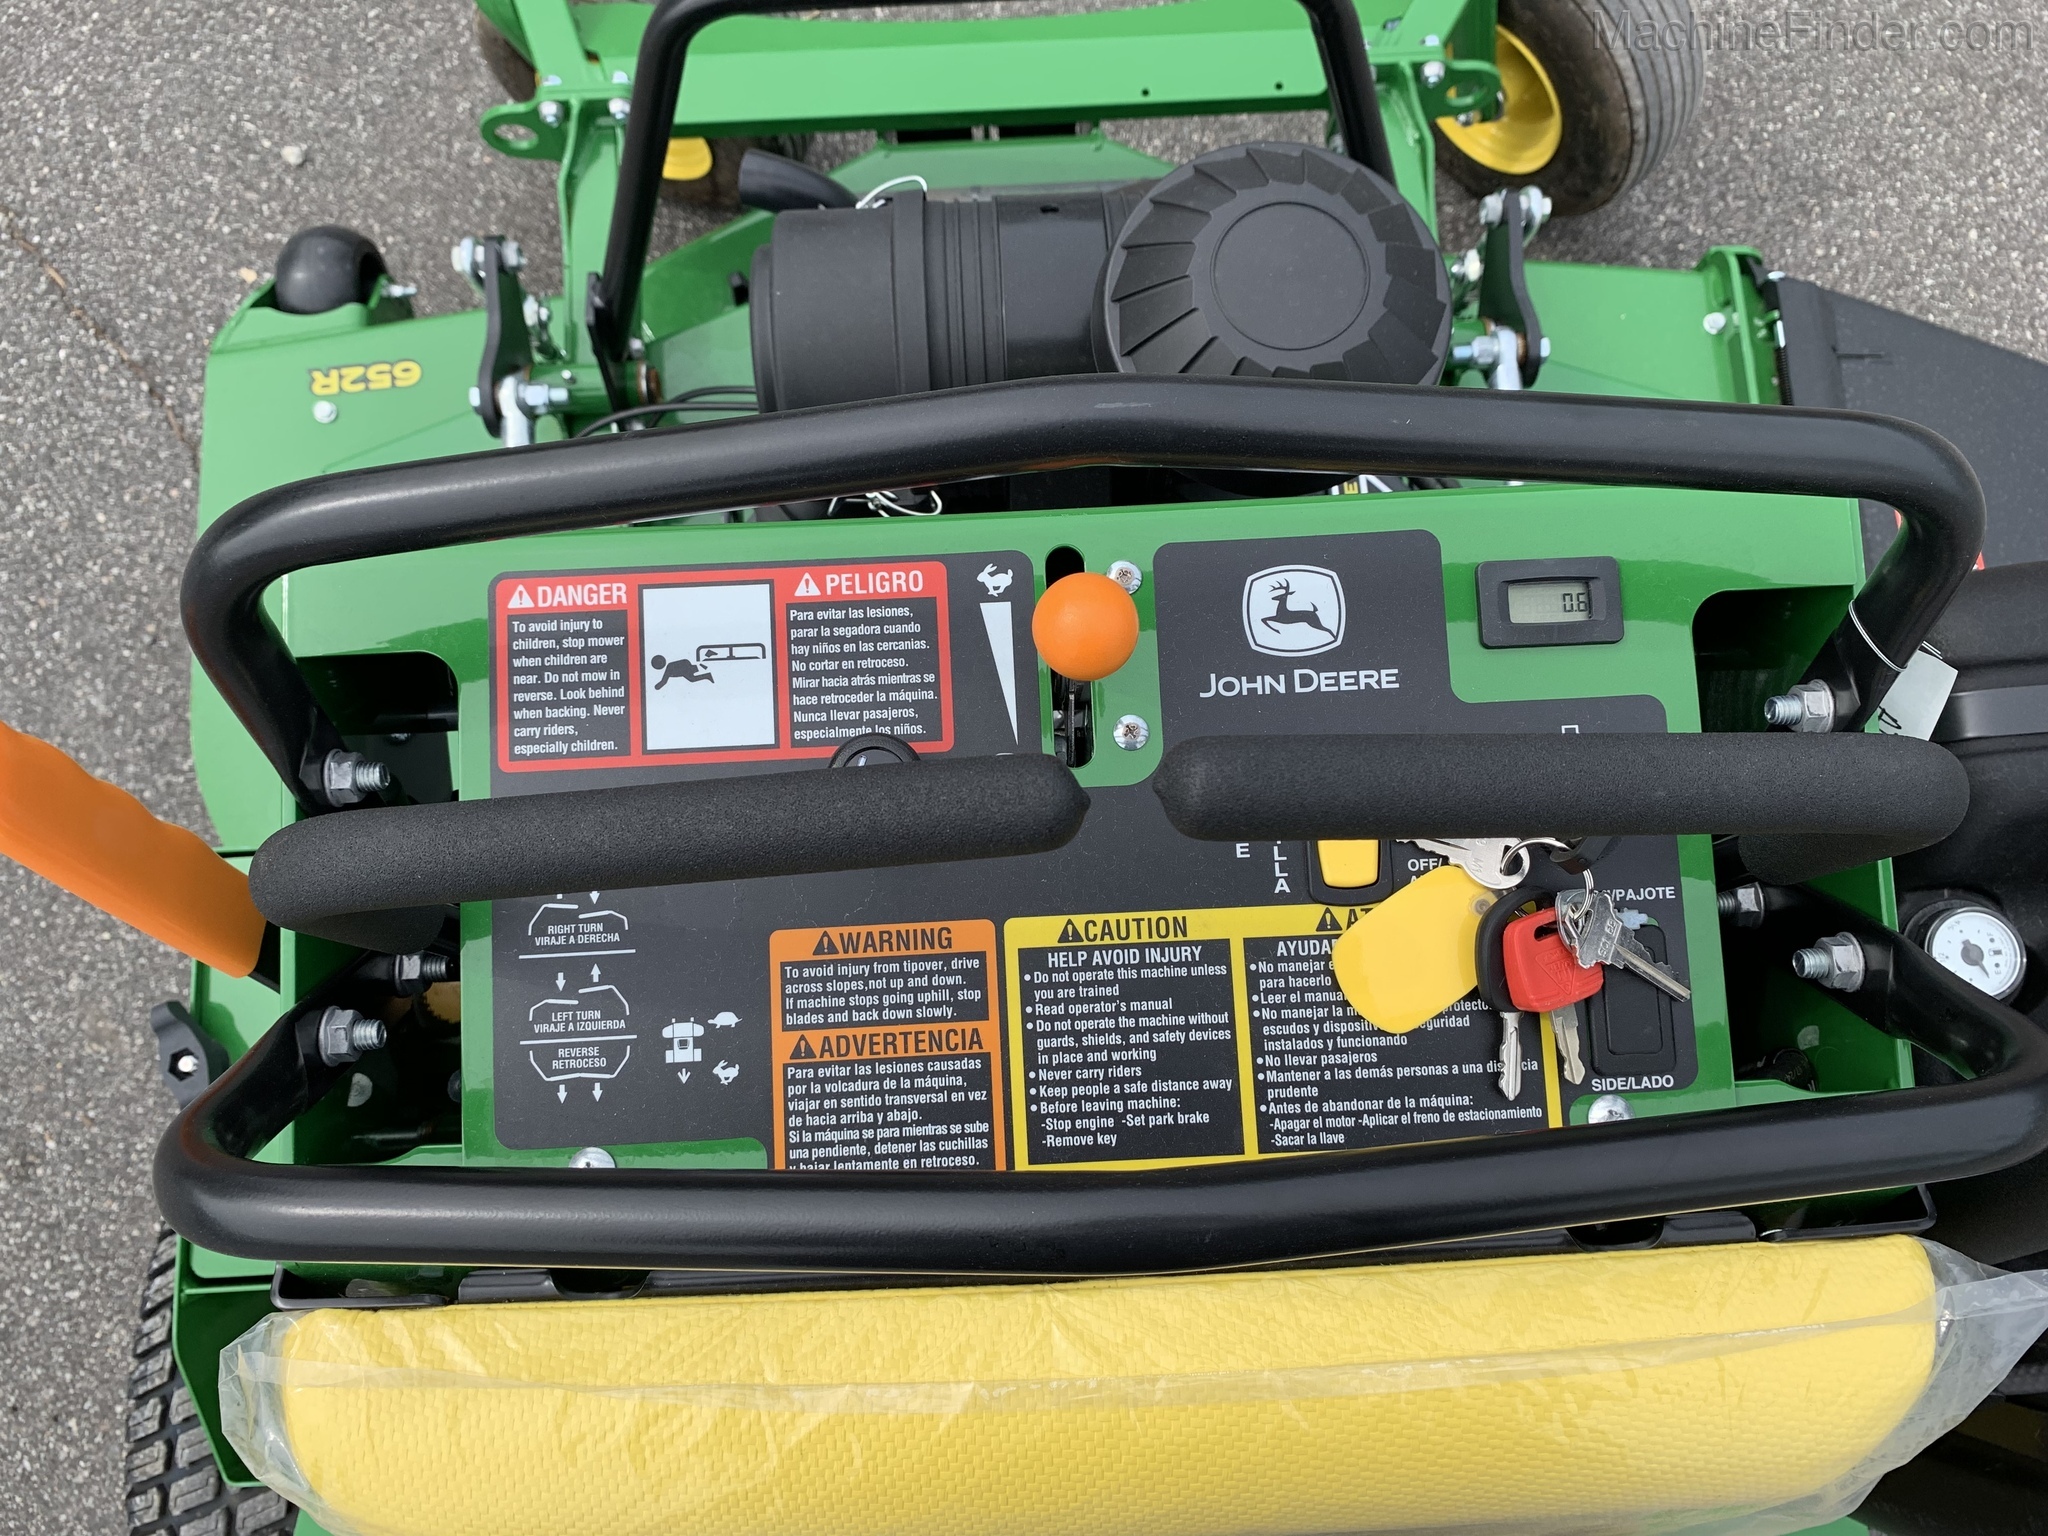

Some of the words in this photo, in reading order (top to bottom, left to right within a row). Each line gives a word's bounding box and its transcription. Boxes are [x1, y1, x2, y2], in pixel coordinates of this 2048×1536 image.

[310, 359, 422, 396] 652R
[826, 570, 923, 595] PELIGRO
[538, 583, 627, 608] DANGER
[1563, 592, 1588, 613] 0.6
[790, 610, 814, 621] Para
[817, 608, 847, 620] evitar
[849, 607, 864, 619] las
[867, 606, 913, 618] lesiones,
[512, 621, 526, 633] To
[529, 620, 558, 632] avoid
[560, 619, 591, 633] injury
[592, 618, 603, 630] to
[791, 628, 819, 641] parar
[821, 626, 831, 637] la
[833, 624, 881, 638] segadora
[884, 622, 921, 634] cuando
[513, 638, 560, 651] children,
[562, 637, 585, 650] stop
[588, 637, 625, 647] mower
[791, 644, 810, 657] hay
[813, 642, 841, 654] niños
[843, 643, 856, 653] en
[859, 641, 875, 652] las
[513, 656, 542, 668] when
[544, 654, 588, 666] children
[590, 654, 608, 664] are
[792, 660, 807, 672] No
[809, 659, 840, 671] cortar
[842, 660, 855, 670] en
[857, 658, 909, 669] retroceso.
[513, 675, 541, 685] near.
[544, 672, 559, 683] Do
[562, 671, 579, 683] not
[581, 672, 608, 682] mow
[610, 669, 620, 681] in
[1200, 673, 1286, 698] JOHN
[1294, 669, 1400, 693] DEERE
[514, 692, 557, 702] reverse.
[560, 688, 586, 700] Look
[589, 686, 625, 699] behind
[793, 694, 818, 706] hace
[821, 691, 874, 705] retroceder
[877, 691, 886, 702] la
[889, 689, 938, 703] máquina.
[514, 708, 543, 720] when
[545, 706, 590, 719] backing.
[594, 704, 626, 716] Never
[794, 711, 827, 723] Nunca
[830, 709, 861, 721] llevar
[863, 707, 918, 722] pasajeros,
[514, 727, 541, 739] carry
[544, 724, 578, 736] riders,
[514, 741, 569, 757] especially
[571, 739, 618, 752] children.
[1273, 841, 1291, 893] LLA
[1594, 886, 1676, 902] /PAJOTE
[548, 924, 576, 935] RIGHT
[578, 923, 603, 933] TURN
[1083, 916, 1188, 943] CAUTION
[535, 936, 567, 946] VIRAJE
[569, 935, 576, 944] A
[578, 933, 620, 944] DERECHA
[839, 927, 953, 954] WARNING
[1048, 951, 1088, 968] HELP
[1092, 949, 1140, 966] AVOID
[1145, 946, 1202, 964] INJURY
[784, 966, 799, 979] To
[803, 964, 834, 978] avoid
[838, 963, 870, 978] injury
[873, 962, 900, 974] from
[903, 960, 947, 974] tipover,
[951, 957, 980, 970] drive
[1034, 972, 1049, 984] Do
[1052, 971, 1070, 983] not
[1072, 969, 1114, 984] operate
[1117, 967, 1138, 980] this
[1141, 965, 1188, 979] machine
[1191, 964, 1227, 976] unless
[786, 997, 794, 1010] If
[797, 995, 846, 1009] machine
[849, 994, 879, 1008] stops
[883, 992, 914, 1007] going
[918, 989, 954, 1005] uphill,
[958, 989, 981, 1002] stop
[1034, 990, 1054, 1002] you
[1057, 988, 1076, 999] are
[1079, 984, 1120, 997] trained
[786, 1012, 825, 1025] blades
[828, 1010, 849, 1023] and
[852, 1009, 879, 1022] back
[882, 1008, 913, 1020] down
[916, 1005, 957, 1019] slowly.
[1035, 1003, 1065, 1016] Read
[1130, 997, 1173, 1011] manual
[552, 1011, 574, 1022] LEFT
[576, 1010, 601, 1021] TURN
[534, 1023, 566, 1034] VIRAJE
[568, 1022, 575, 1032] A
[577, 1020, 626, 1031] IZQUIERDA
[819, 1028, 984, 1059] ADVERTENCIA
[1264, 1037, 1324, 1051] instalados
[1327, 1039, 1334, 1051] y
[1336, 1032, 1408, 1048] funcionando
[558, 1047, 600, 1058] REVERSE
[1265, 1055, 1281, 1067] No
[1285, 1054, 1318, 1066] llevar
[1321, 1051, 1378, 1067] pasajeros
[552, 1057, 607, 1070] RETROCESO
[788, 1067, 814, 1080] Para
[818, 1065, 851, 1078] evitar
[855, 1063, 872, 1076] las
[876, 1061, 924, 1075] lesiones
[928, 1057, 982, 1072] causadas
[1039, 1069, 1073, 1081] Never
[1076, 1069, 1105, 1081] carry
[1108, 1065, 1142, 1078] riders
[1040, 1085, 1068, 1099] Keep
[1072, 1082, 1110, 1099] people
[1114, 1084, 1121, 1094] a
[1124, 1081, 1148, 1094] safe
[1151, 1080, 1199, 1092] distance
[1203, 1079, 1232, 1092] away
[1592, 1075, 1674, 1092] SIDE/LADO
[1268, 1085, 1319, 1101] prudente
[1269, 1102, 1301, 1115] Antes
[1305, 1101, 1319, 1113] de
[1322, 1098, 1384, 1112] abandonar
[1387, 1097, 1401, 1109] de
[1405, 1096, 1416, 1108] la
[1419, 1094, 1474, 1109] máquina:
[789, 1115, 803, 1127] de
[806, 1113, 837, 1126] hacia
[840, 1111, 874, 1124] arriba
[877, 1112, 884, 1125] y
[887, 1108, 922, 1123] abajo.
[1271, 1134, 1305, 1147] -Sacar
[1307, 1133, 1317, 1145] la
[1320, 1132, 1345, 1144] llave
[790, 1149, 809, 1160] una
[812, 1144, 871, 1161] pendiente,
[874, 1142, 917, 1155] detener
[920, 1140, 936, 1152] las
[939, 1137, 988, 1151] cuchillas
